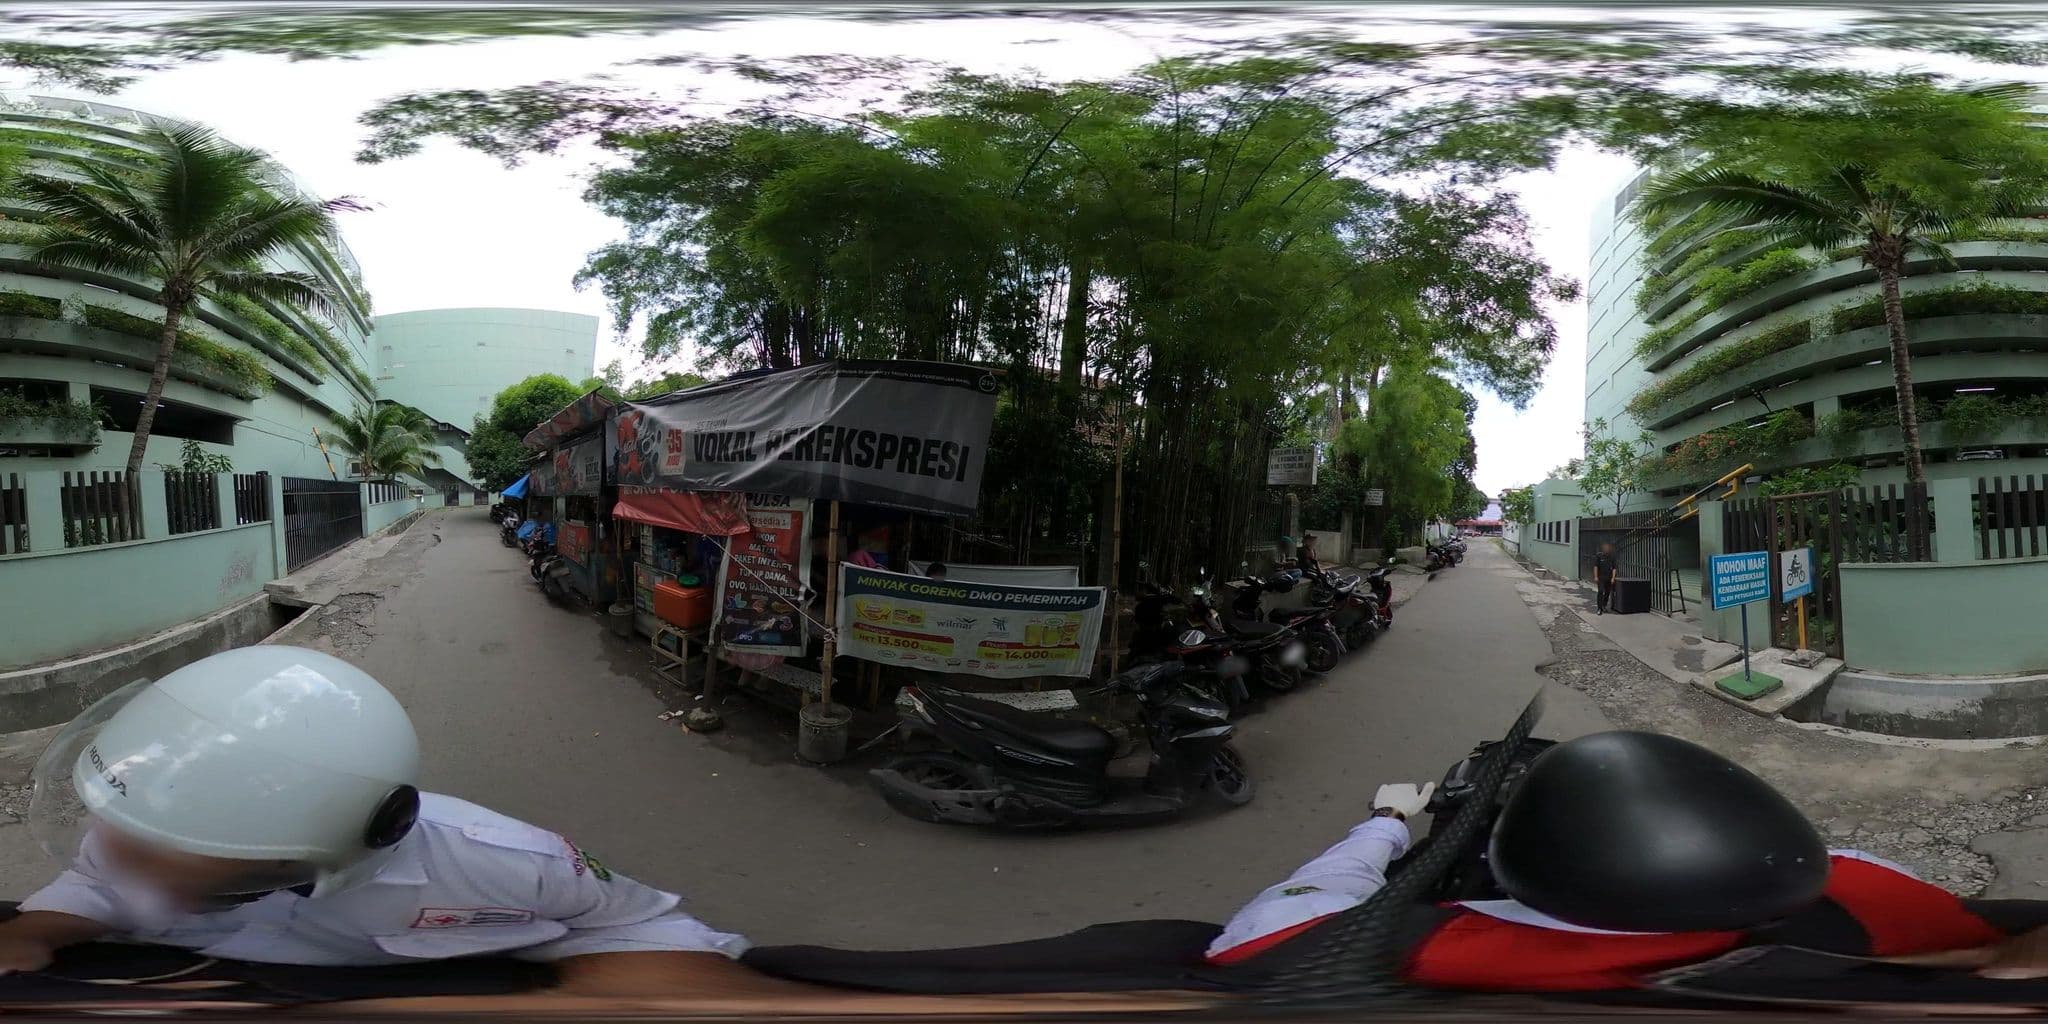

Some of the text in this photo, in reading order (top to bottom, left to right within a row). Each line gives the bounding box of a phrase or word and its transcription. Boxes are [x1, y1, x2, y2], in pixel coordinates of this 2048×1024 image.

[667, 428, 682, 454] 35
[693, 430, 757, 463] VOKAL
[747, 492, 791, 508] PULSA
[750, 516, 780, 526] ersedia
[1716, 557, 1766, 574] MOHON MAAF
[764, 571, 788, 583] DANA,
[729, 580, 748, 592] OVO,
[857, 576, 1088, 605] MINYAK GORENG DMO PEMERINTAH
[936, 618, 973, 630] wilmar
[878, 636, 919, 650] 13.500
[1004, 650, 1049, 660] 14.000
[90, 745, 127, 798] HONDA
